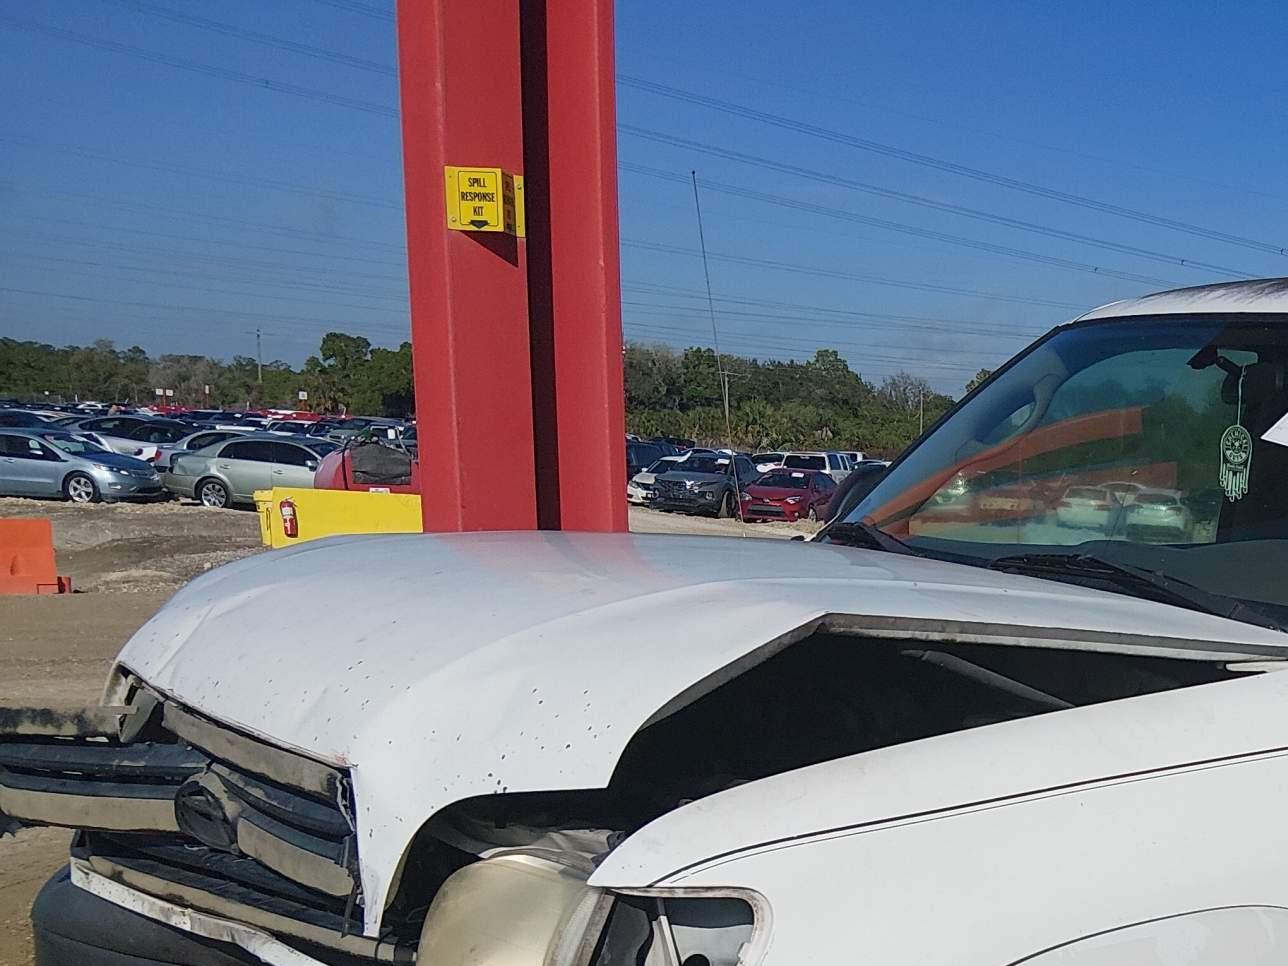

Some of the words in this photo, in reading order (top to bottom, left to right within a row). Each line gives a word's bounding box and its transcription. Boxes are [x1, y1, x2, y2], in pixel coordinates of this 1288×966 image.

[468, 177, 487, 188] SPILL
[461, 191, 496, 203] RESPONSE
[473, 206, 484, 217] KIT
